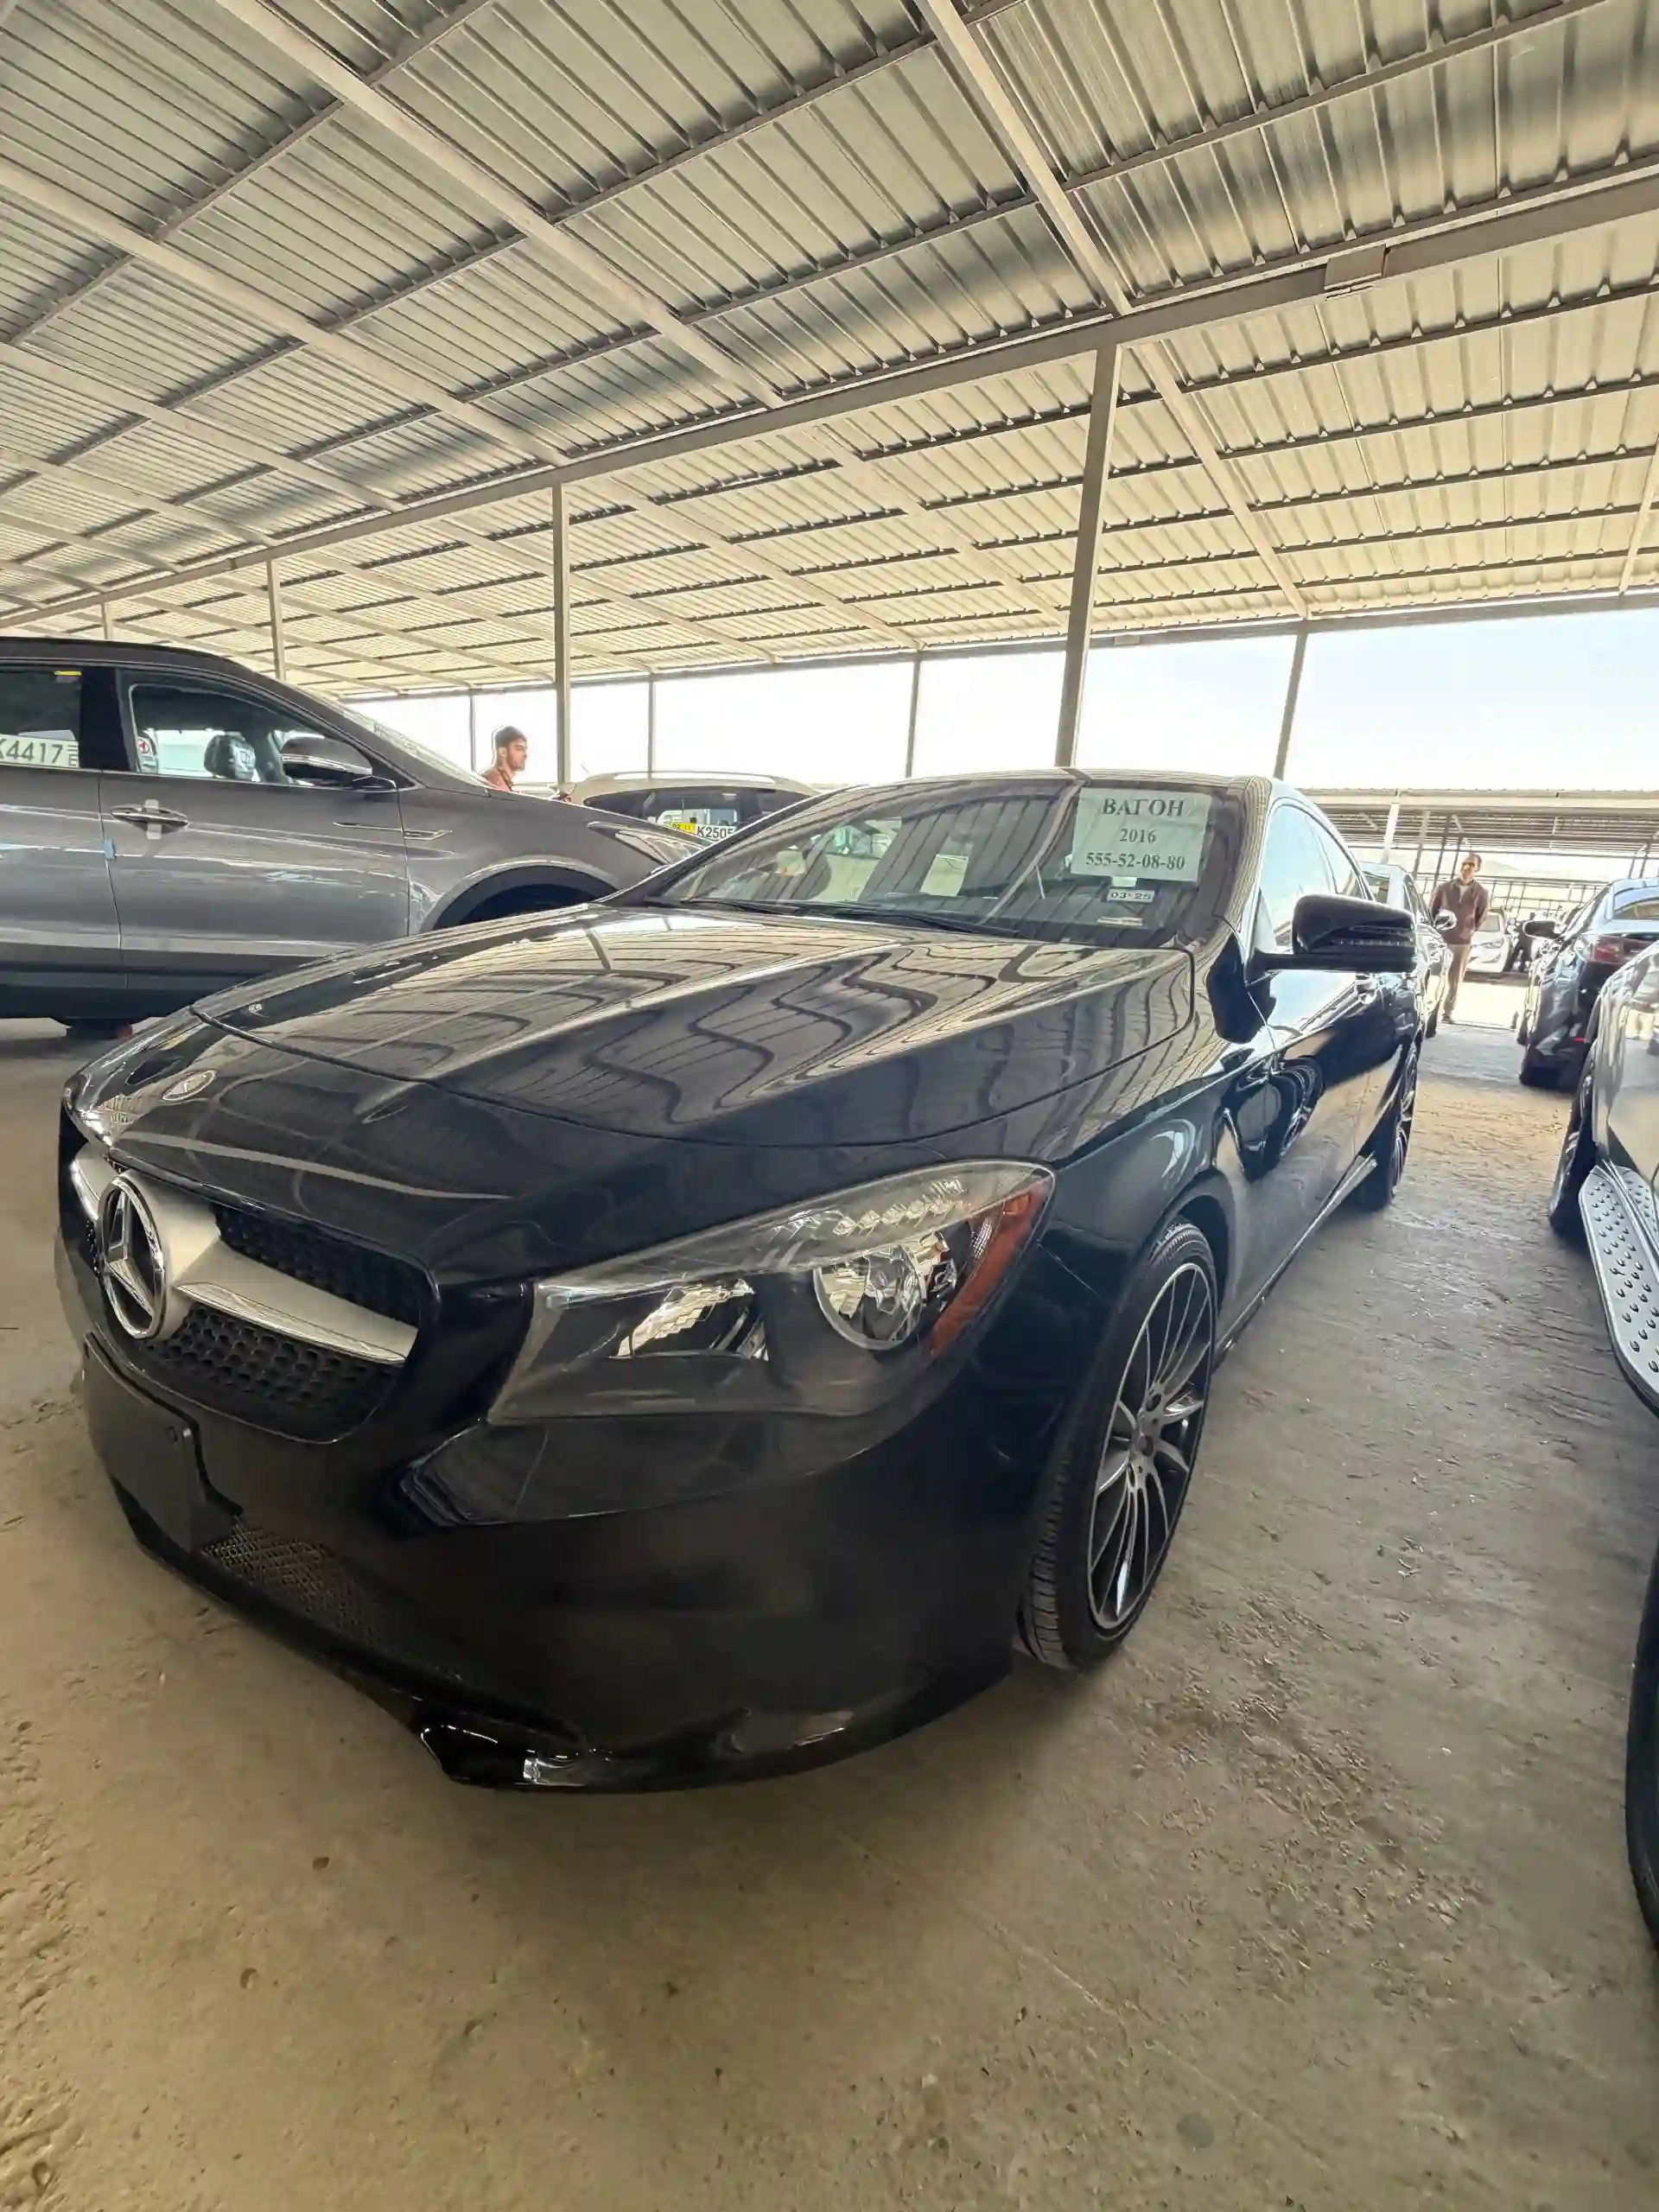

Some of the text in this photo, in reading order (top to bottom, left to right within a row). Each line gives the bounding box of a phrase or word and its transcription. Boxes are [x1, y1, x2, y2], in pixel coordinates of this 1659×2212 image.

[1103, 797, 1185, 817] ВАГОН
[1120, 828, 1156, 843] 2016
[1085, 852, 1185, 870] 555-52-08-80
